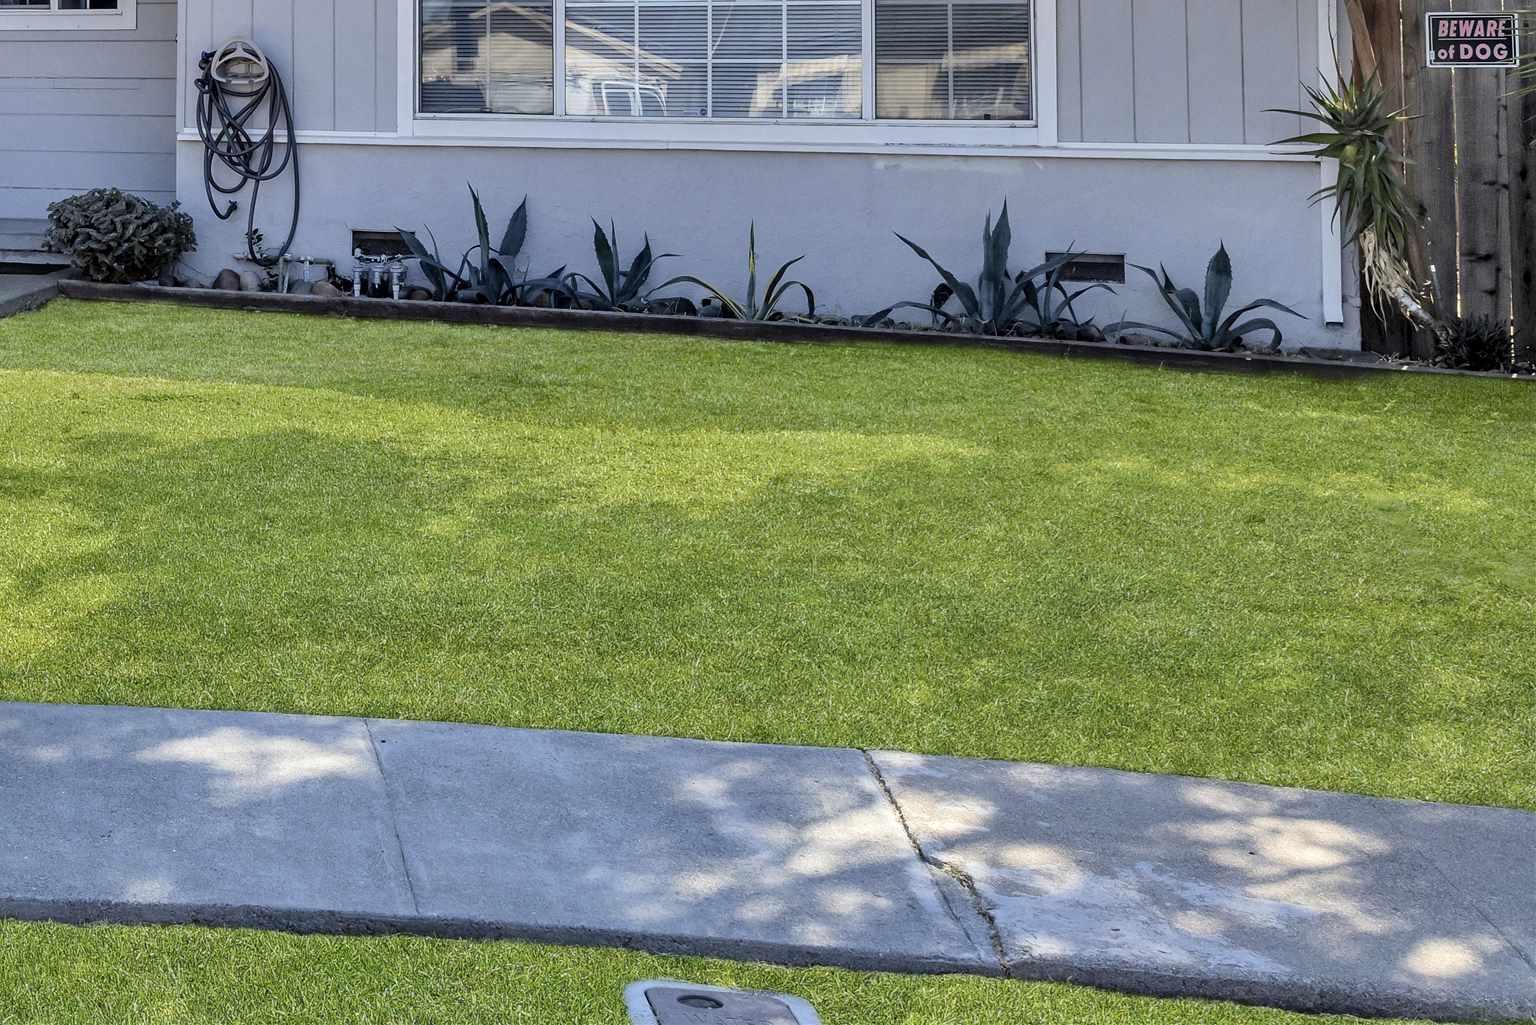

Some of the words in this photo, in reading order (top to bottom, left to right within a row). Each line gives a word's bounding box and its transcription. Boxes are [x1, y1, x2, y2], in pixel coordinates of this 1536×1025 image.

[1438, 19, 1506, 37] BEWARE
[1437, 44, 1455, 60] of
[1459, 43, 1509, 60] DOG
